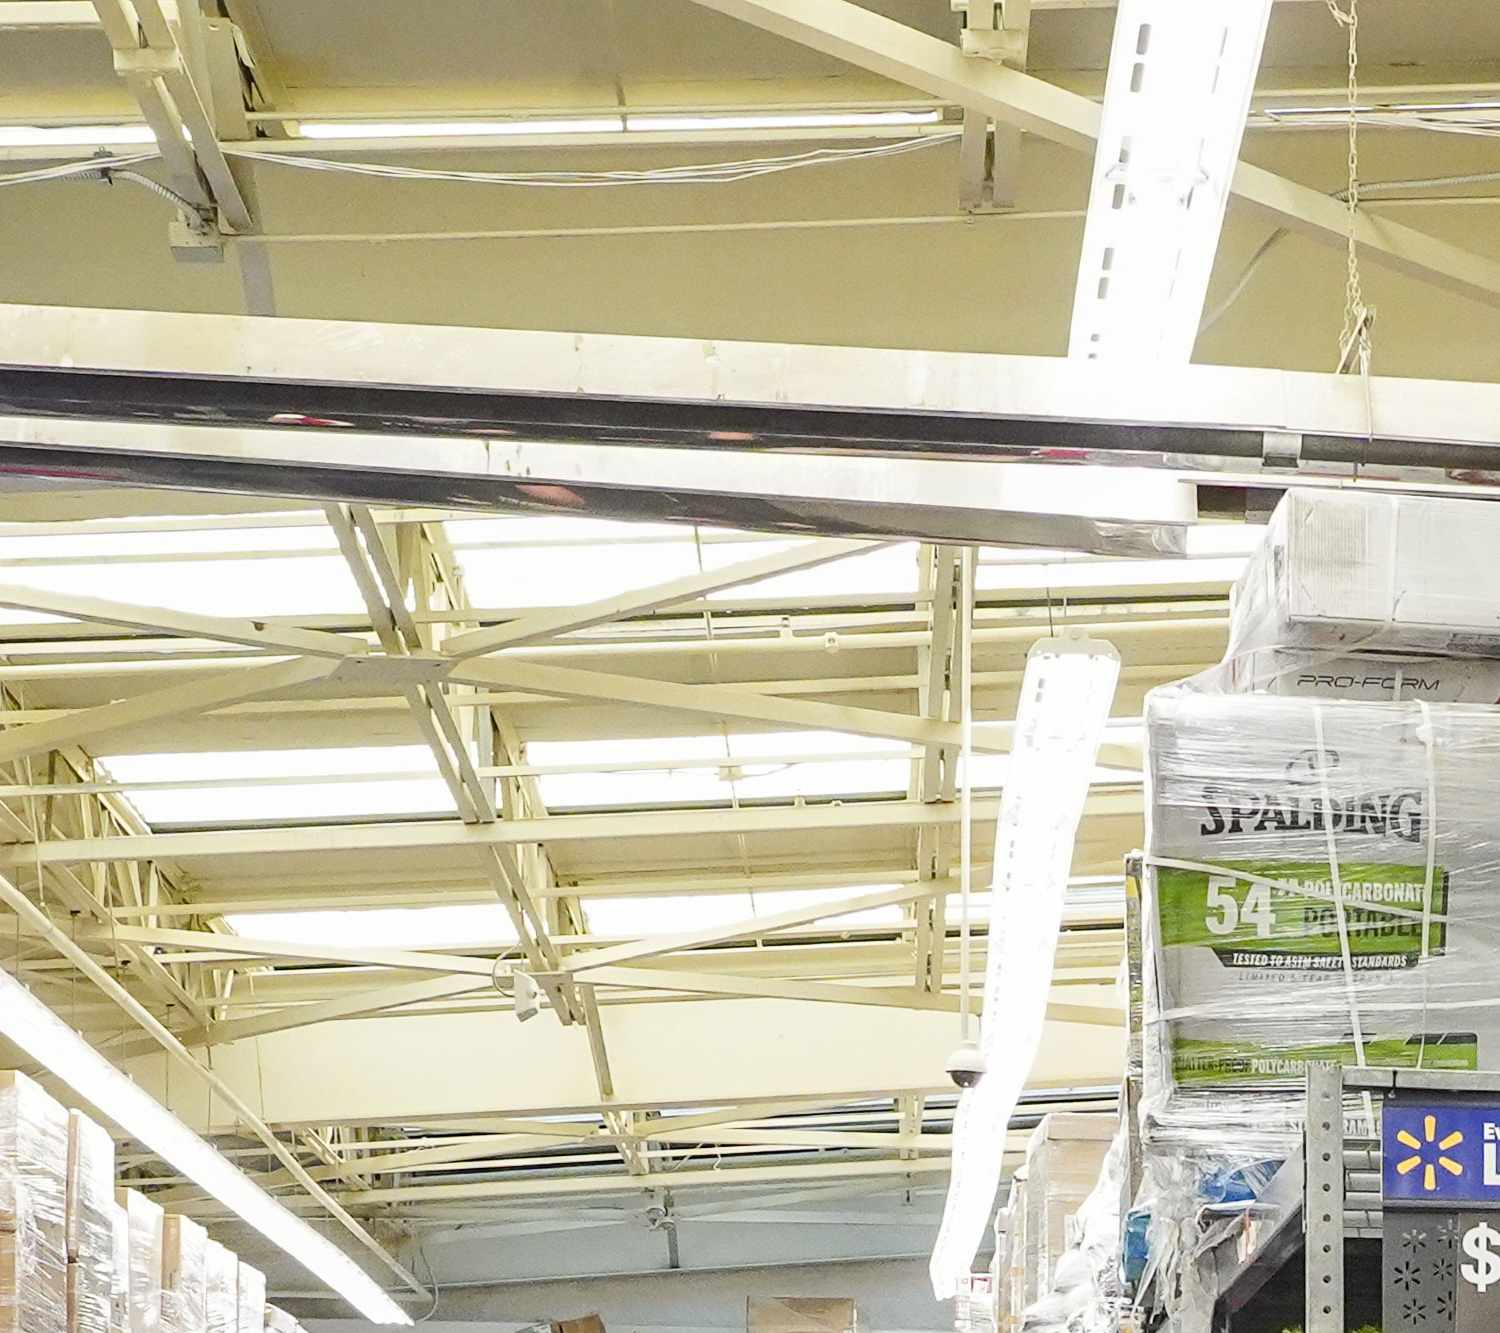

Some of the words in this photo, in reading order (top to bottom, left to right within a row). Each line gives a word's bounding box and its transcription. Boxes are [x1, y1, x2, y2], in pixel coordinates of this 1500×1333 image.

[1297, 675, 1440, 692] PRO-FORM
[1200, 786, 1423, 843] SPALDING
[1204, 874, 1277, 938] 54
[1312, 955, 1347, 968] SAFET
[1351, 954, 1408, 968] STANDARDS
